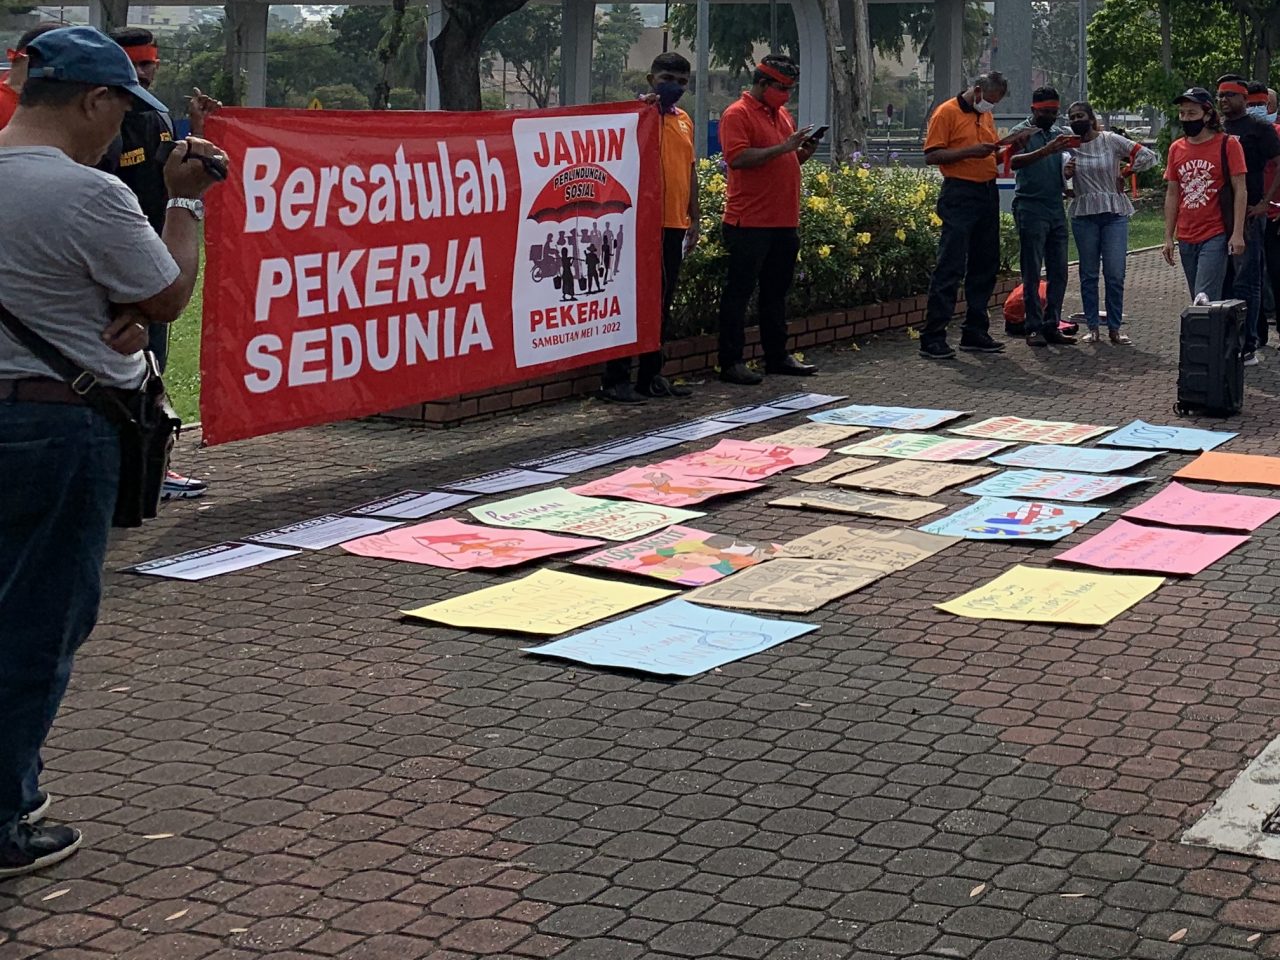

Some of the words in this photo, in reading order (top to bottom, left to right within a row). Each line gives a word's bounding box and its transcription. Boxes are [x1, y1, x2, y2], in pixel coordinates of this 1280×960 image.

[534, 128, 625, 167] JAMIN
[554, 167, 607, 190] PERLINDUNGAN
[1178, 159, 1215, 176] MAYDAY
[243, 139, 507, 233] Bersatulah
[565, 183, 595, 200] SOSIAL
[254, 237, 486, 322] PEKERJA
[530, 296, 621, 332] PEKERJA
[244, 302, 493, 394] SEDUNIA
[532, 330, 579, 349] SAMBUTAN
[581, 327, 593, 338] MEI
[596, 326, 599, 335] 1
[602, 322, 621, 334] 2022
[249, 530, 280, 541] HAK
[279, 515, 342, 535] PEKERJA
[134, 558, 173, 570] ALAM
[174, 545, 232, 561] SEKITAR
